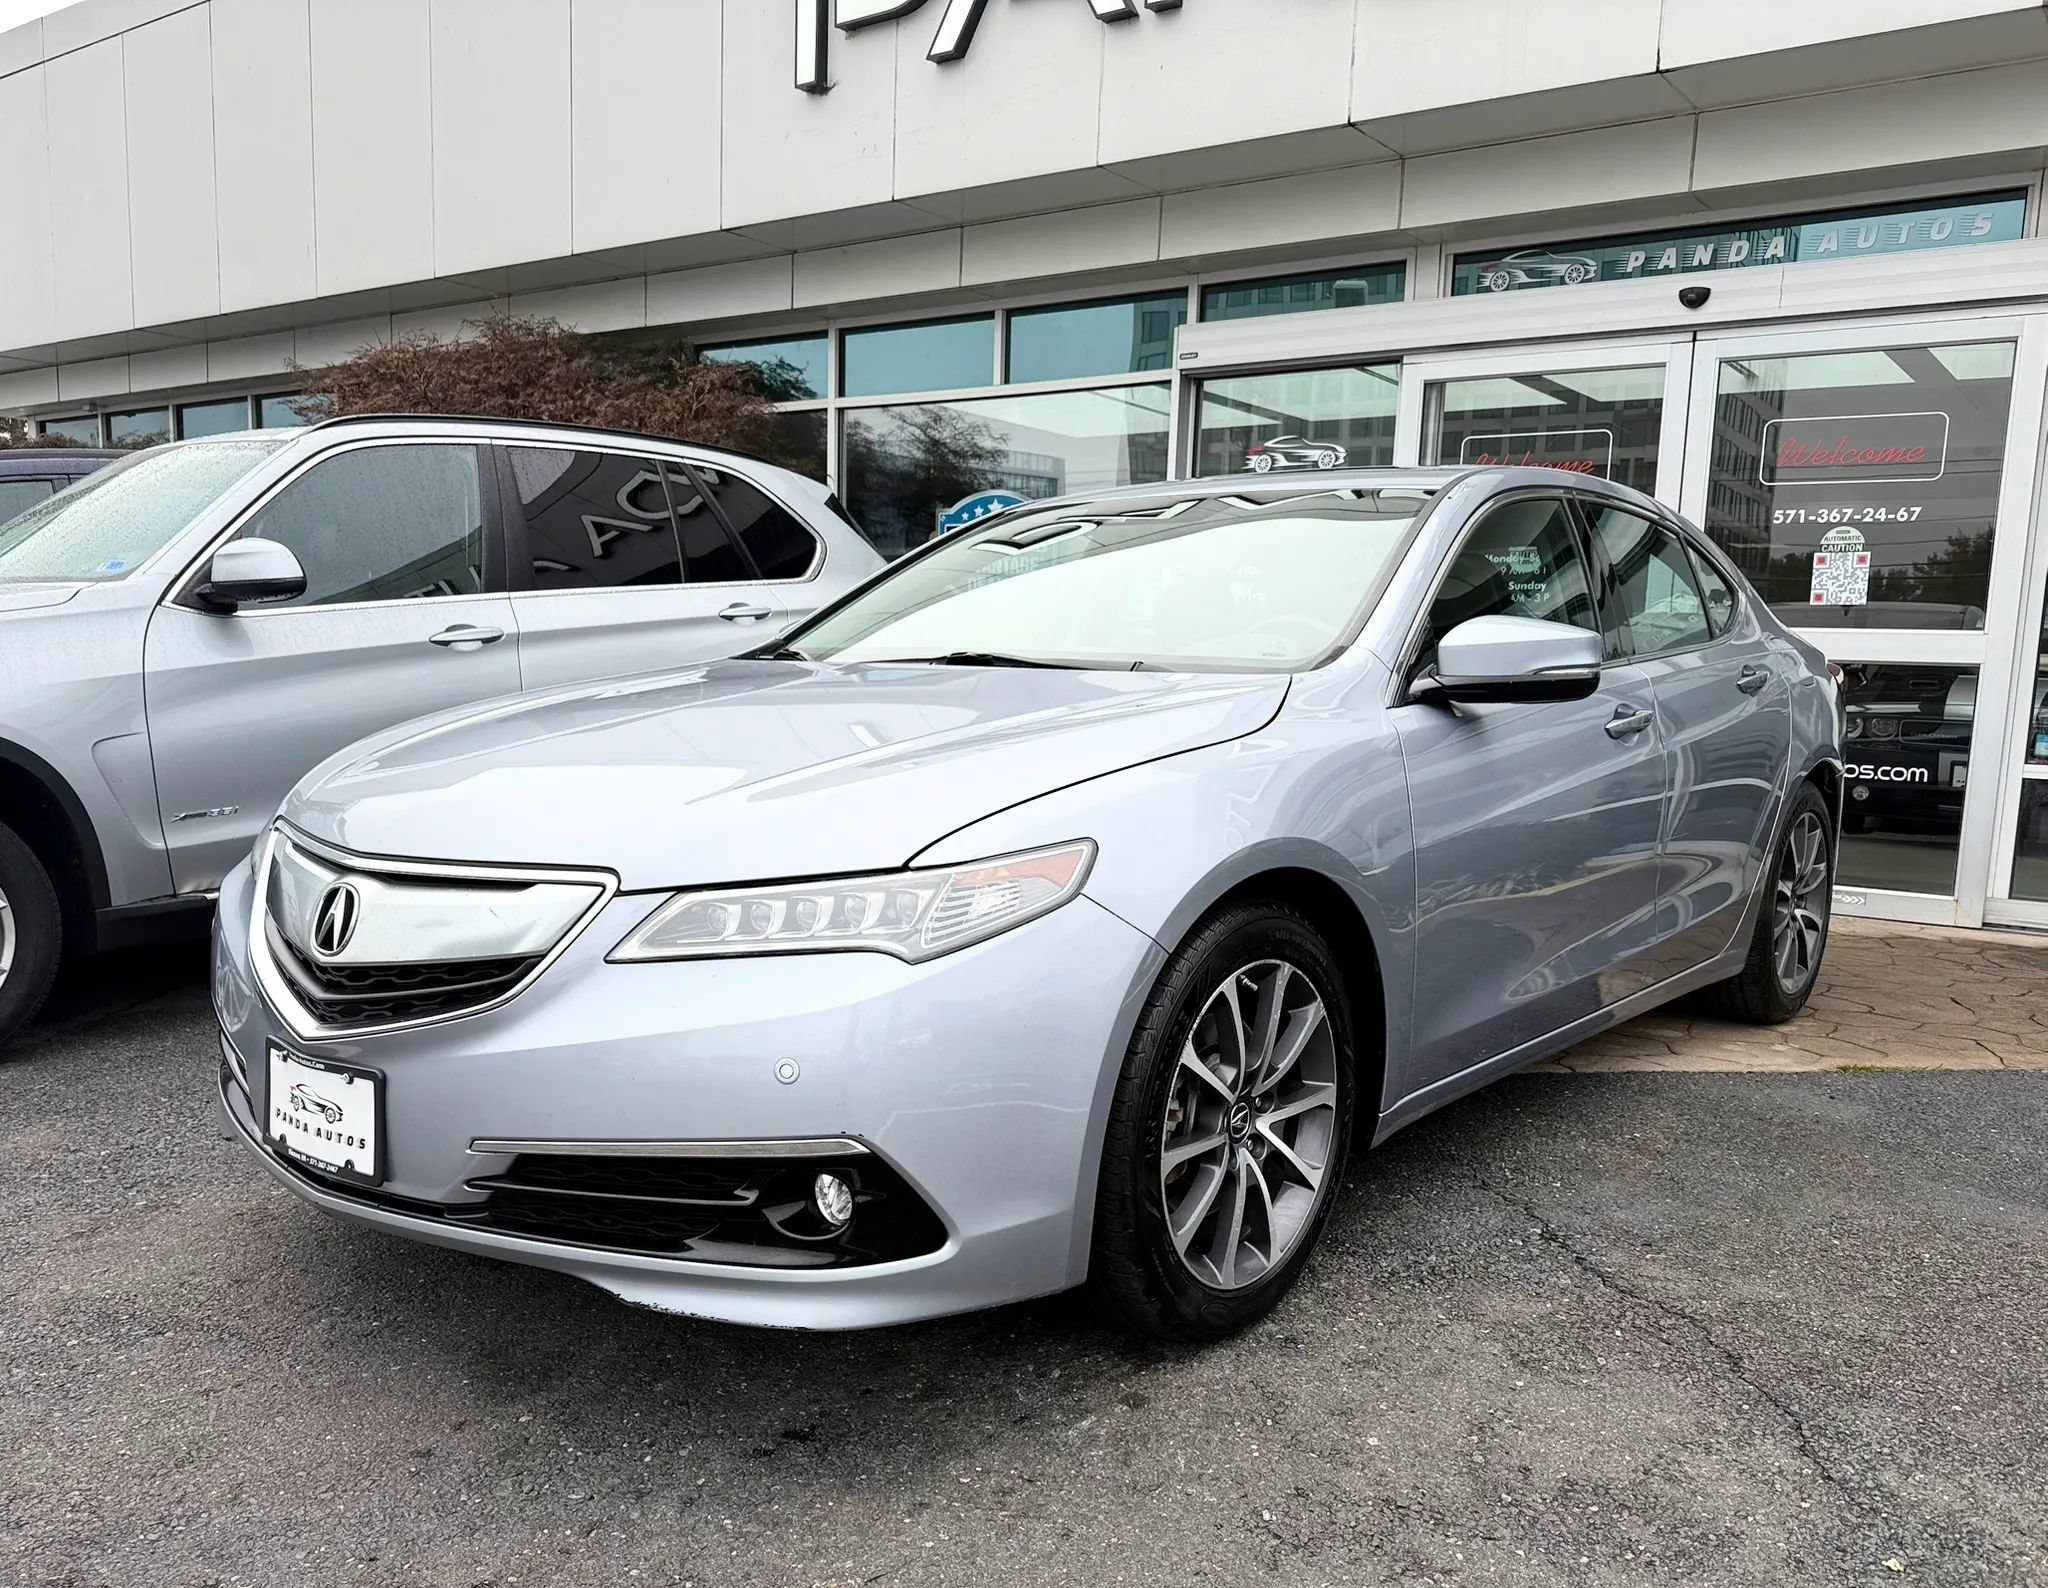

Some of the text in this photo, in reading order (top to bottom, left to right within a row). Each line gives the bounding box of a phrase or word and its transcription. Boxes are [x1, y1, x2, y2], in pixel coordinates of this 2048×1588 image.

[1617, 211, 1994, 273] PANDA AUTOS
[1778, 434, 1927, 465] Welcome
[1773, 506, 1923, 524] 571-367-24-67
[1821, 543, 1863, 552] CAUTION
[1508, 581, 1547, 592] Sunday
[276, 1107, 366, 1150] PANDA AUTOS
